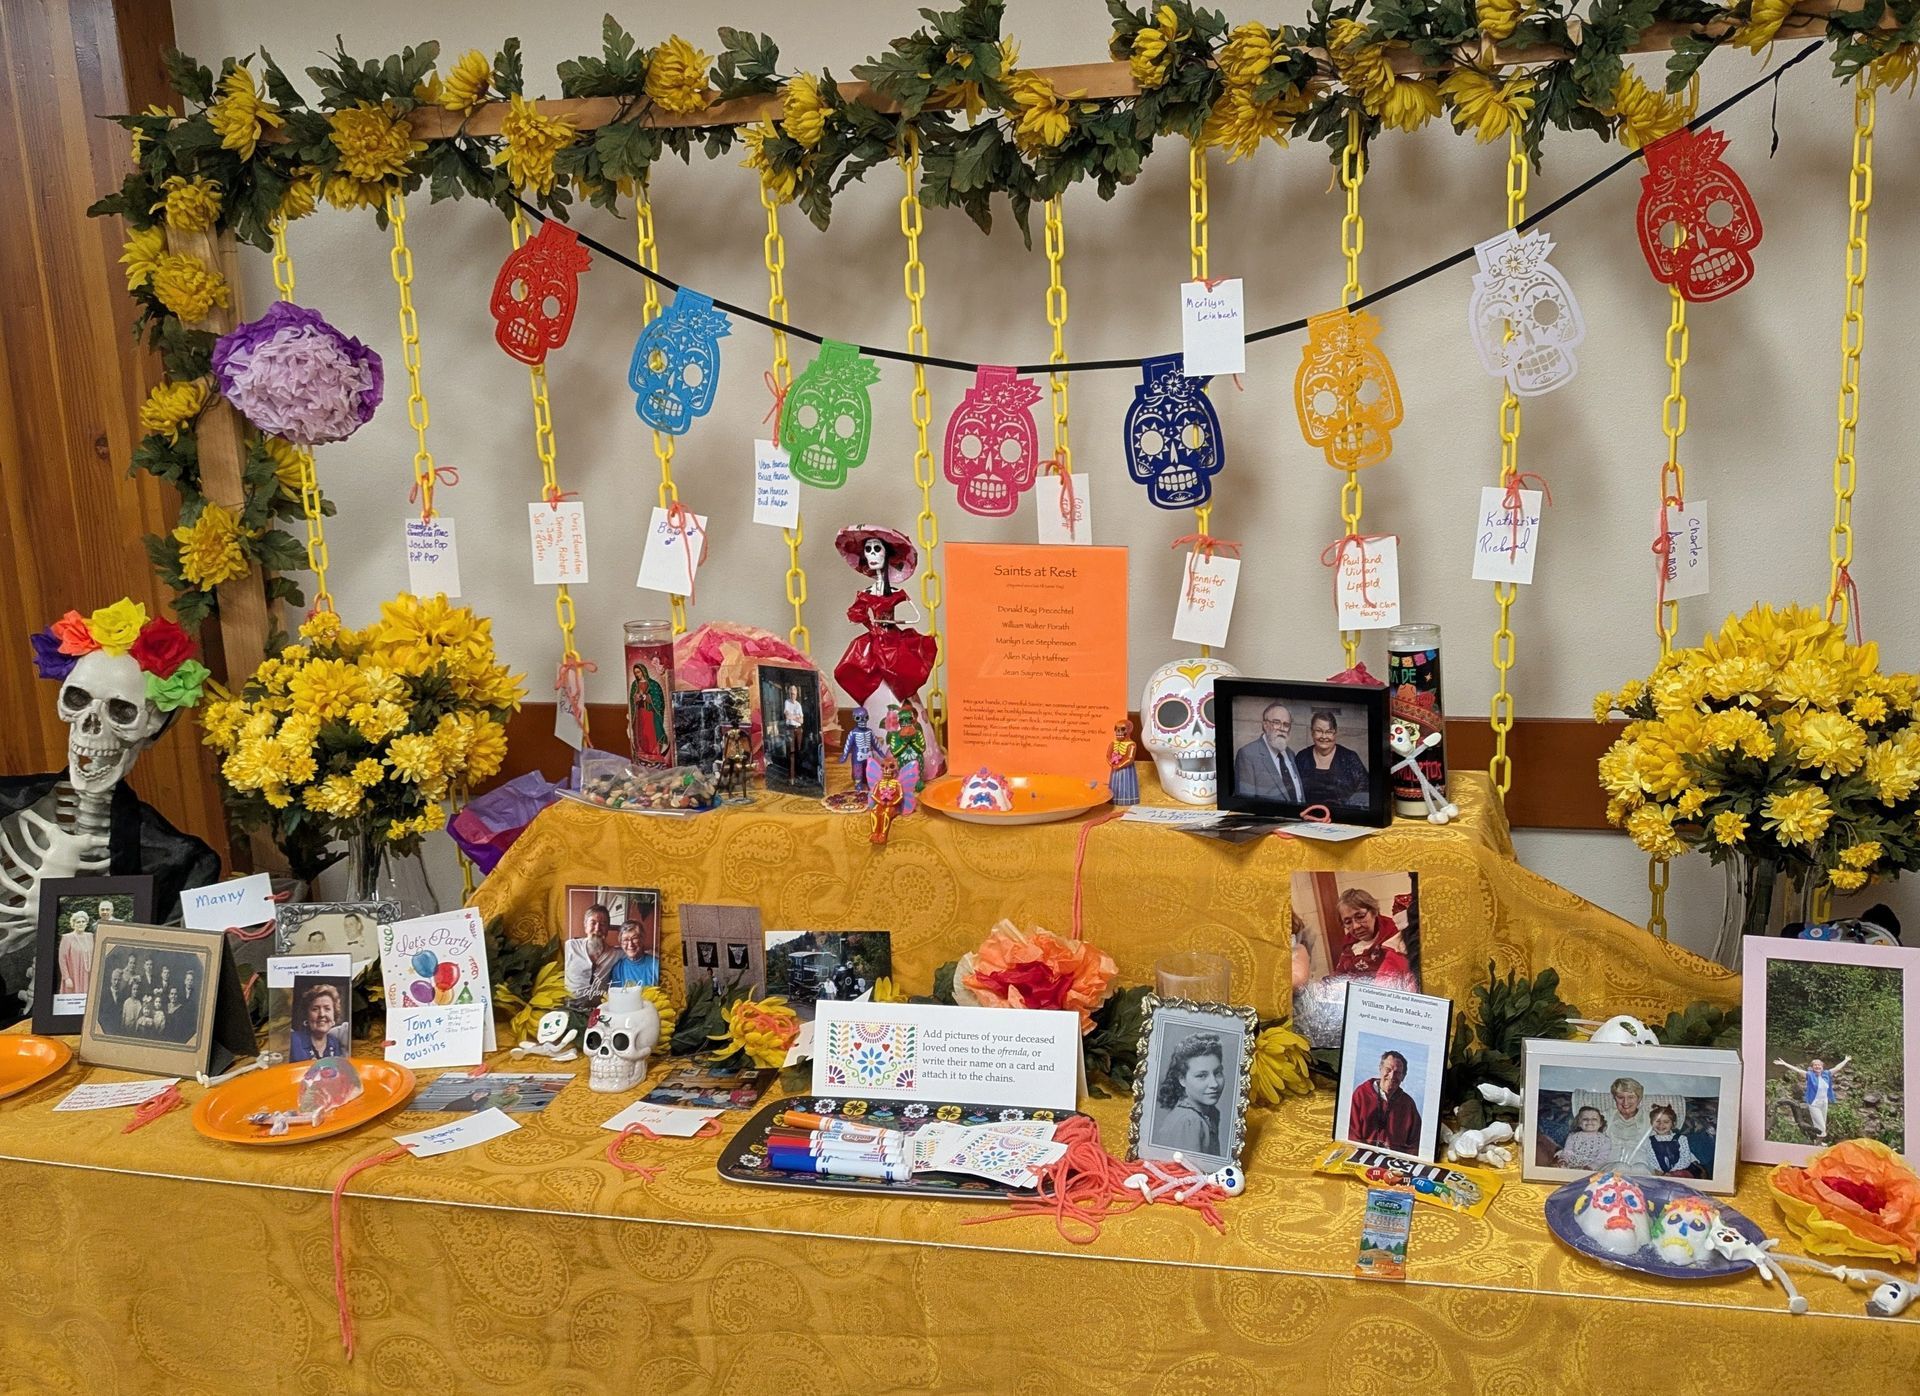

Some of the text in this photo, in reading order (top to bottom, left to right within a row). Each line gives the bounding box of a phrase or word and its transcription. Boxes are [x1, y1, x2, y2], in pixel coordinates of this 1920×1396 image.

[1688, 518, 1703, 568] Charles
[1342, 553, 1360, 566] Paul
[994, 564, 1078, 578] Saints at Rest
[1345, 567, 1377, 576] Vivan
[1191, 583, 1211, 594] Faith
[997, 603, 1023, 613] Donald
[1024, 606, 1037, 616] Ray
[1002, 620, 1024, 629] William
[1024, 620, 1045, 629] Walter
[996, 636, 1077, 648] Marilyn Lee Stephenson
[1003, 651, 1020, 660] Allen
[1021, 652, 1041, 664] Ralph
[1401, 668, 1417, 684] DE
[195, 888, 245, 908] Manny
[395, 928, 473, 958] Let's Party
[1361, 1000, 1433, 1019] William Paden Mack, Jr.
[402, 1014, 432, 1031] Tom
[1392, 1018, 1414, 1028] December
[406, 1030, 439, 1047] other
[922, 1029, 1056, 1044] Add pictures of your deceased
[403, 1041, 447, 1062] cousins
[922, 1042, 1042, 1058] loved ones to the ofrenda, or
[922, 1056, 1056, 1072] write their name on a card and
[921, 1069, 1016, 1084] attach it to the chains.
